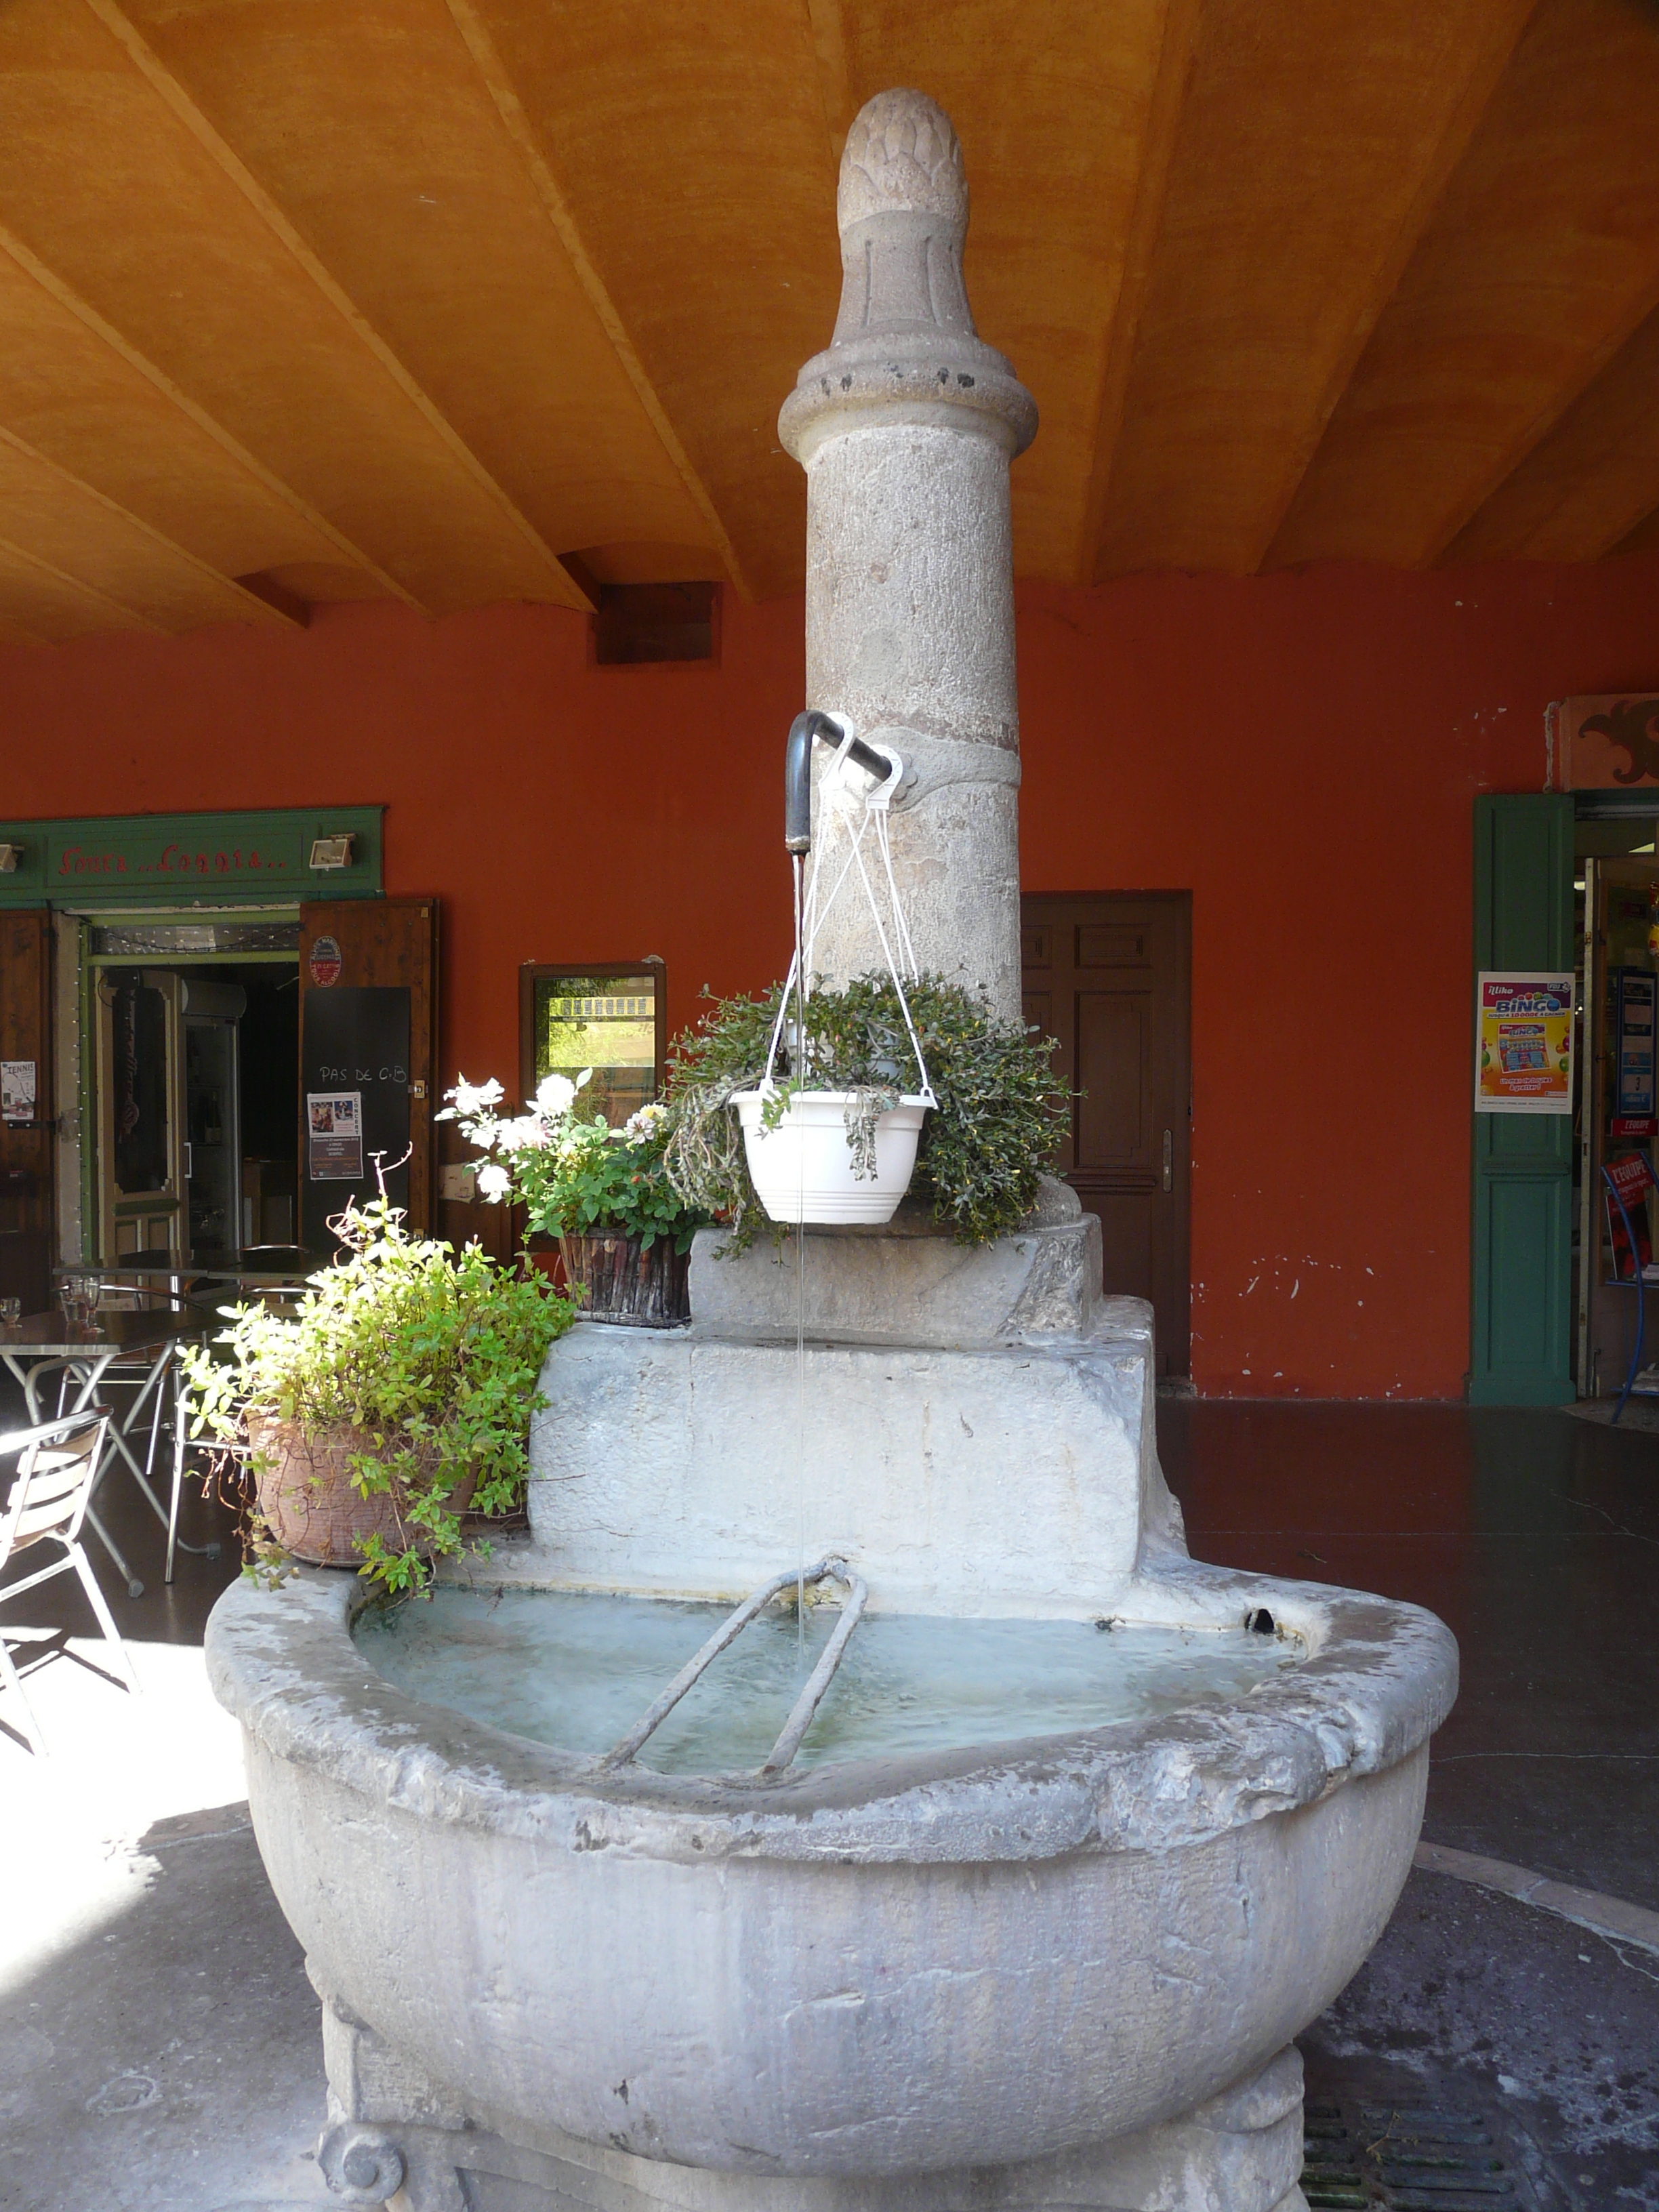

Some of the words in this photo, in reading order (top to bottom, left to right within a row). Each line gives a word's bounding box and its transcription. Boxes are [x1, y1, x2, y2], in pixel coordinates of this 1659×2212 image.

[7, 1063, 34, 1073] TENNIS
[319, 1067, 347, 1082] PAS
[355, 1069, 372, 1081] DE
